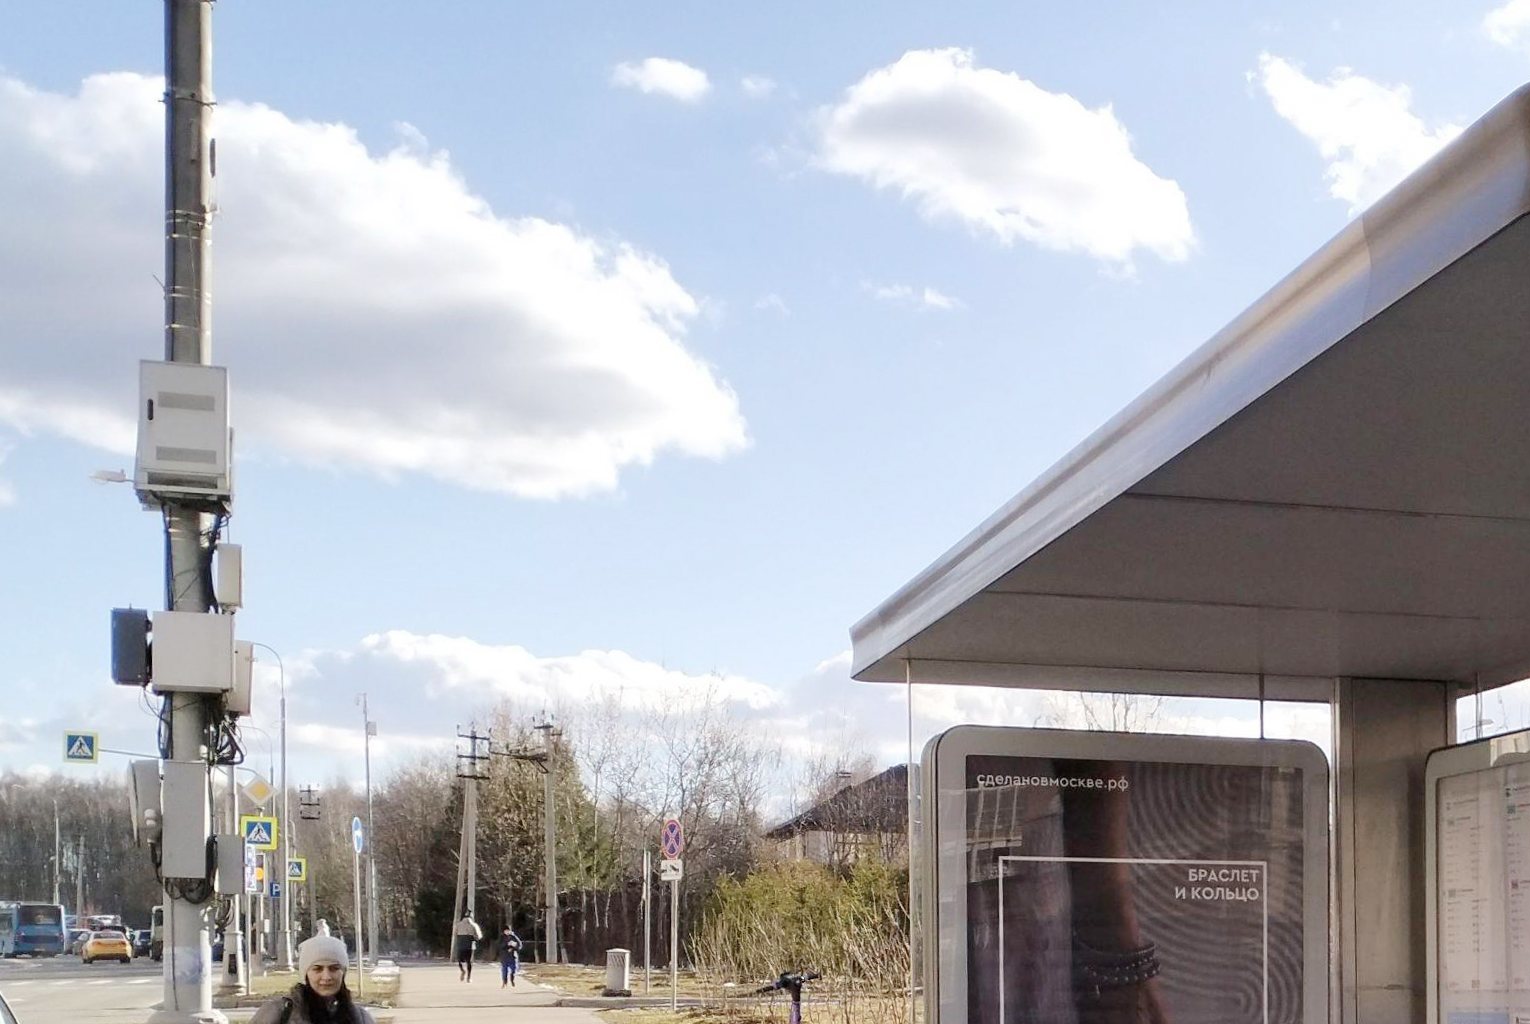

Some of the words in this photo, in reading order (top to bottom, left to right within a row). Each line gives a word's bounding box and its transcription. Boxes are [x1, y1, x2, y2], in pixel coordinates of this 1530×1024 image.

[976, 774, 1129, 792] сделановмоскве.рф
[1187, 868, 1260, 883] БРАСЛЕТ
[1174, 886, 1187, 900] И
[1191, 886, 1260, 902] КОЛЬЦО
